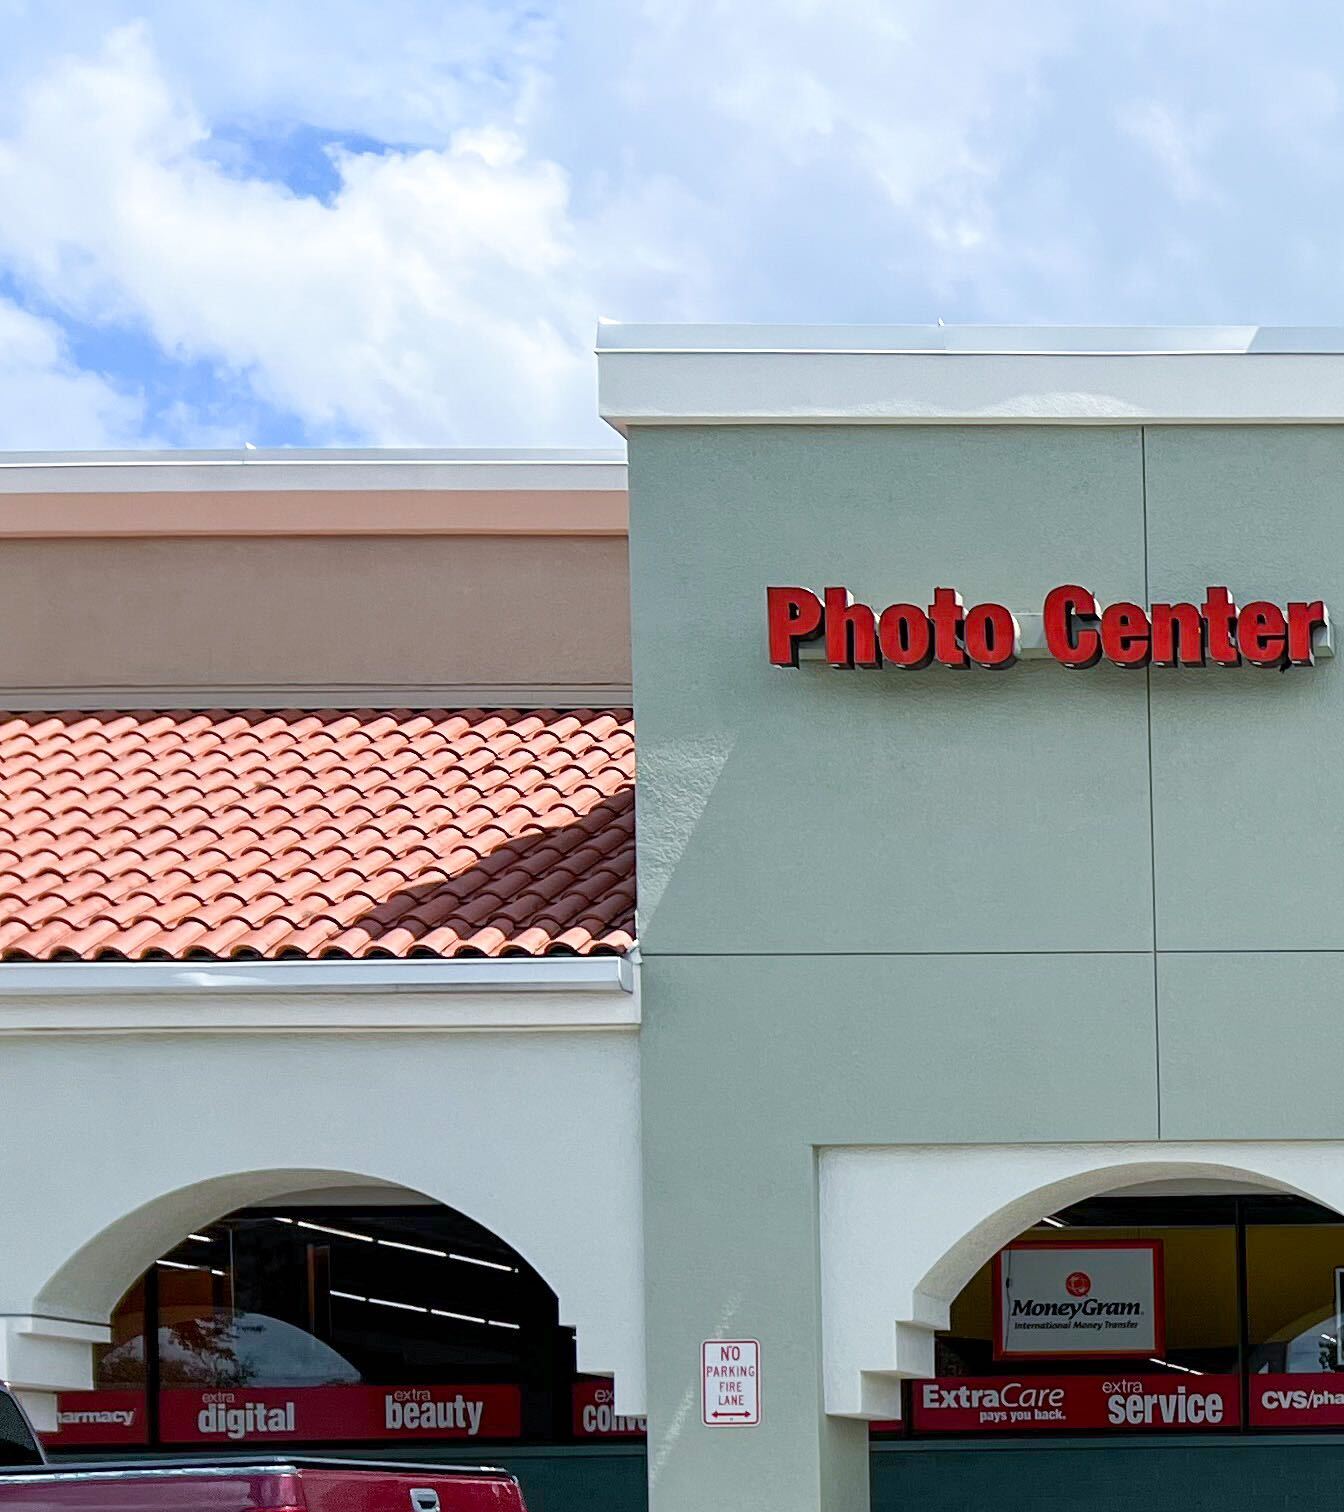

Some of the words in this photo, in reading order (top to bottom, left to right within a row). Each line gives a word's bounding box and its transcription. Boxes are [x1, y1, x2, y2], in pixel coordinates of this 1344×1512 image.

[767, 585, 1018, 669] Photo
[1044, 584, 1329, 668] Center
[1012, 1299, 1141, 1319] MoneyGram
[1014, 1321, 1071, 1330] International
[1073, 1321, 1102, 1331] Money
[1104, 1320, 1138, 1329] Transfer
[720, 1346, 740, 1361] NO
[706, 1365, 755, 1378] PARKING
[719, 1381, 742, 1393] FIRE
[1102, 1379, 1143, 1394] extra
[202, 1391, 235, 1402] extra
[393, 1388, 431, 1401] extra
[718, 1395, 744, 1406] LANE
[922, 1383, 1066, 1408] ExtraCare
[1108, 1386, 1223, 1424] service
[198, 1402, 295, 1439] digital
[385, 1395, 483, 1435] beauty
[980, 1409, 1008, 1422] pays
[1010, 1410, 1031, 1421] you
[1034, 1408, 1067, 1421] back.
